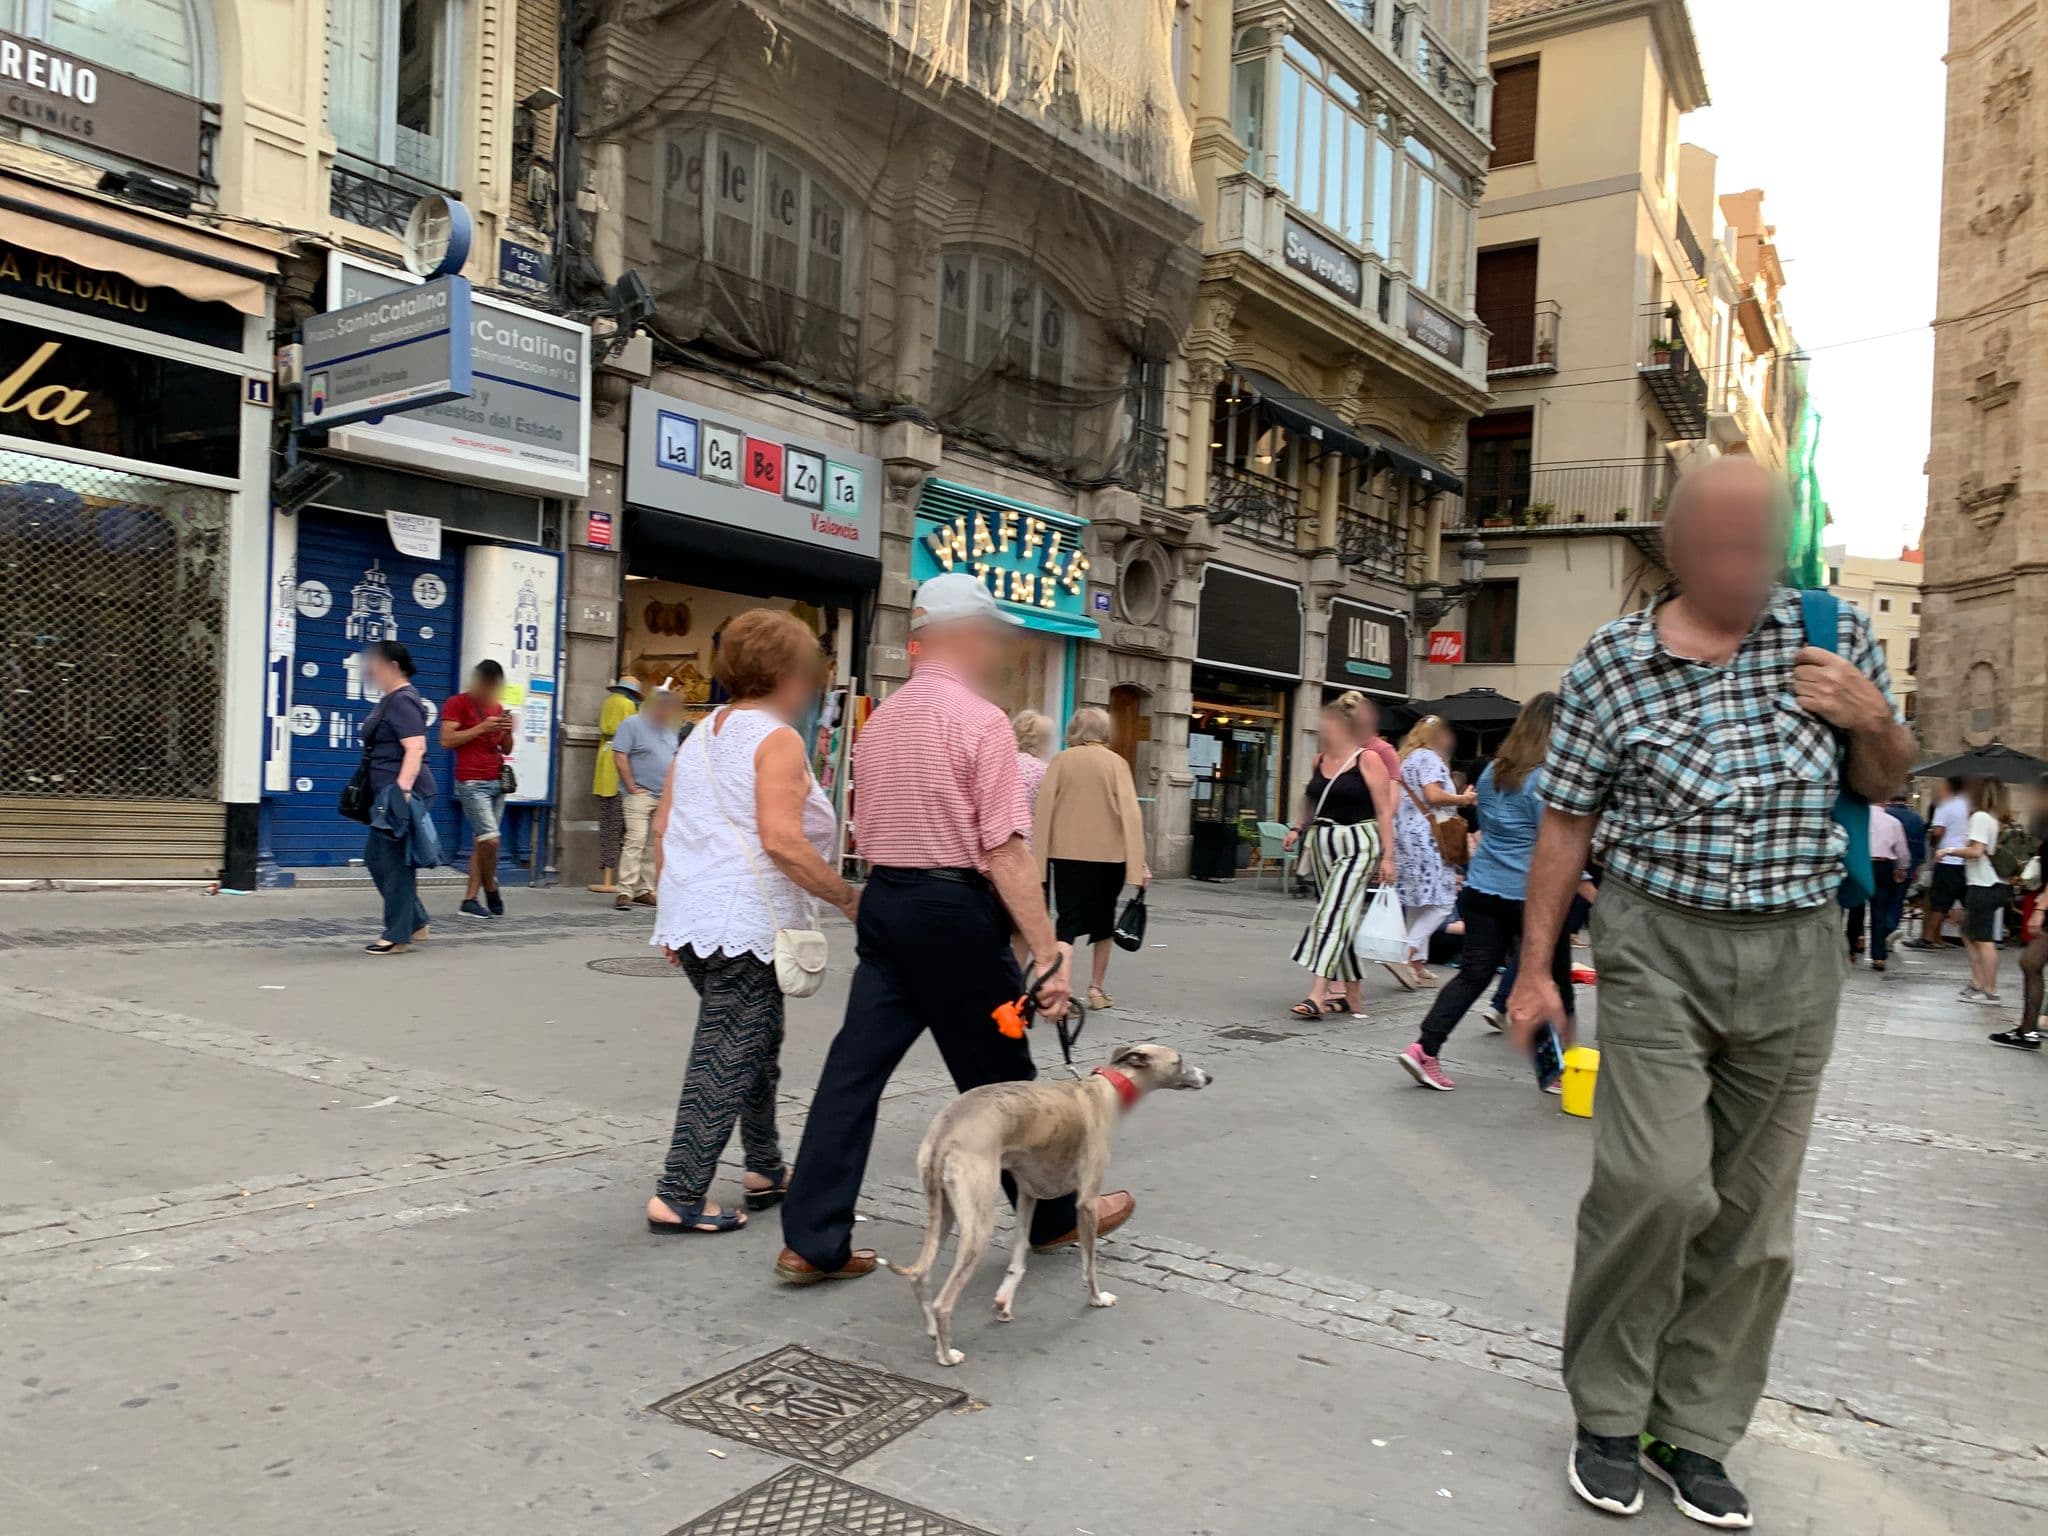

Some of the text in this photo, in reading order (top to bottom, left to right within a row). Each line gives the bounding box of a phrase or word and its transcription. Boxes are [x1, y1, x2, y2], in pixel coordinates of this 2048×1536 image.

[0, 40, 97, 104] RENO
[8, 95, 94, 136] CLINICS
[1286, 232, 1307, 264] Se
[471, 320, 577, 365] Catalina
[667, 436, 855, 504] La Ca Be Zo Ta
[810, 513, 859, 541] Valencia
[419, 581, 439, 600] 13
[514, 624, 538, 651] 13
[1430, 636, 1461, 660] illy
